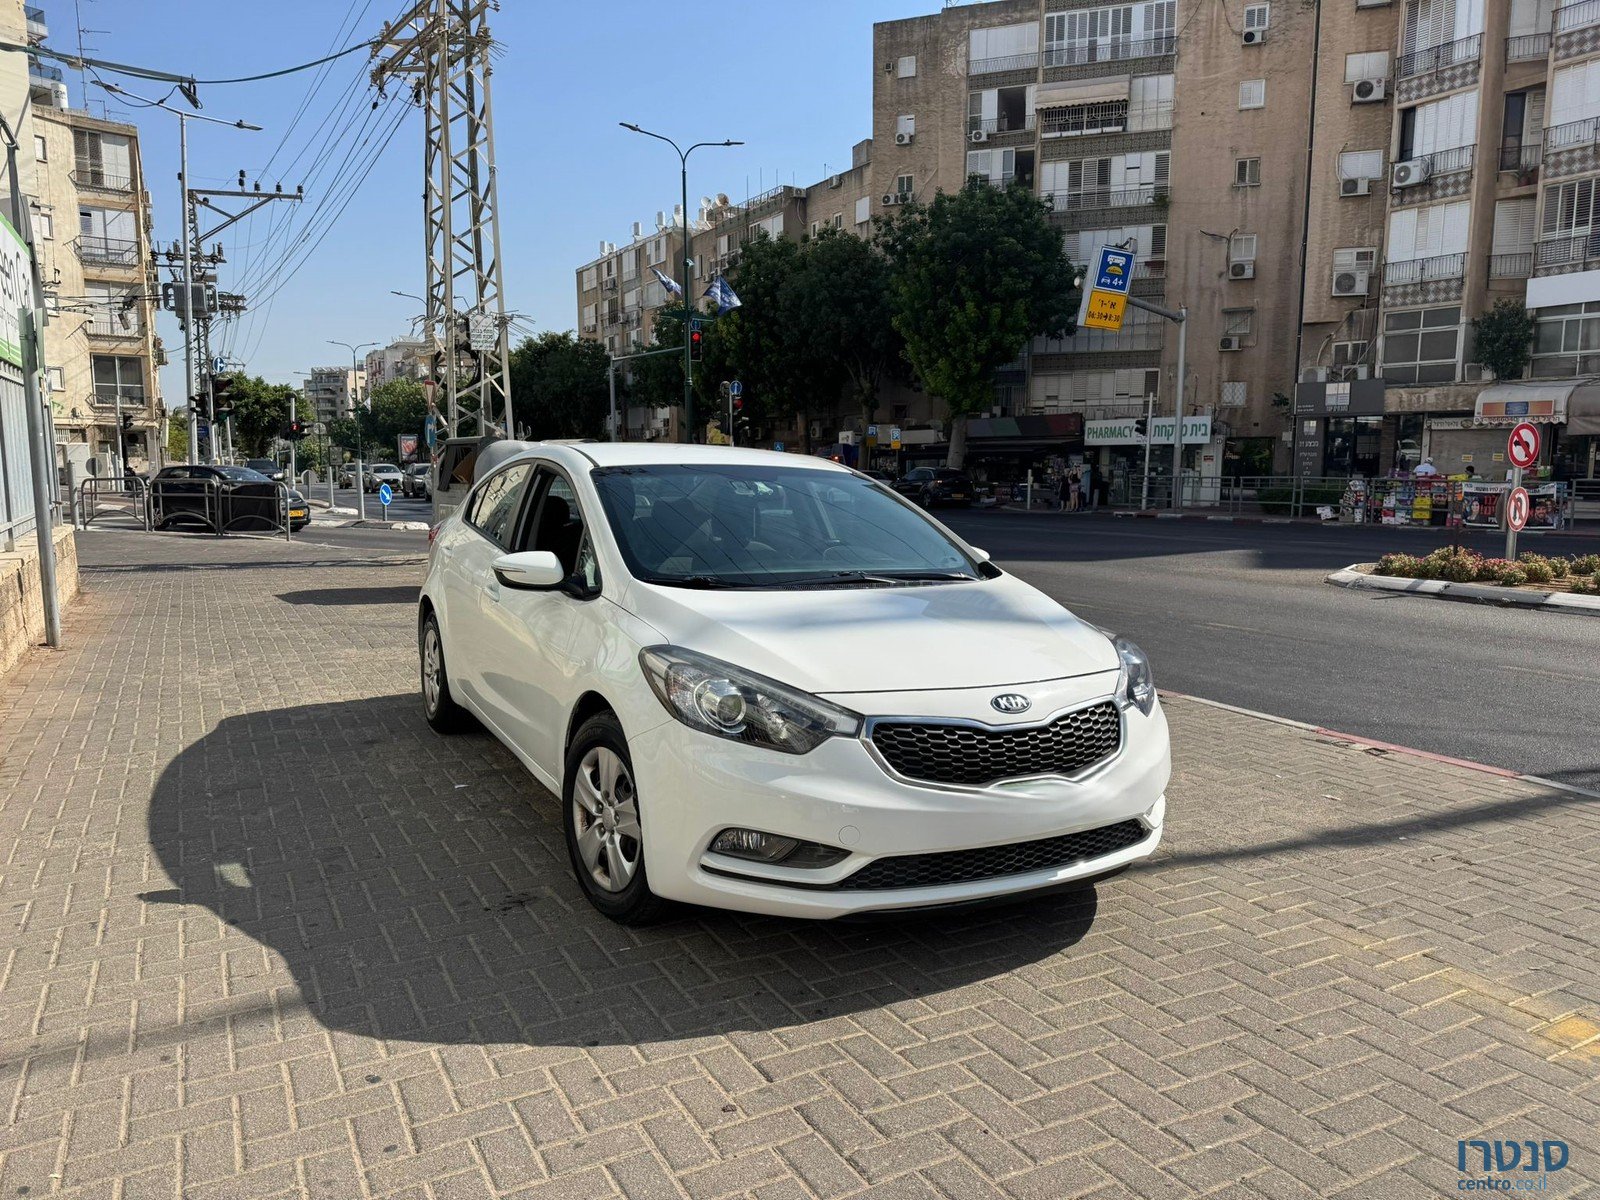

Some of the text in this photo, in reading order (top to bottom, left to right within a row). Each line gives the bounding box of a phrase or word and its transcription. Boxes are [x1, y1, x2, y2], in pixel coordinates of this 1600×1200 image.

[1087, 425, 1135, 439] PHARMACY
[1152, 423, 1209, 440] בית מקחת
[997, 695, 1027, 709] KIA
